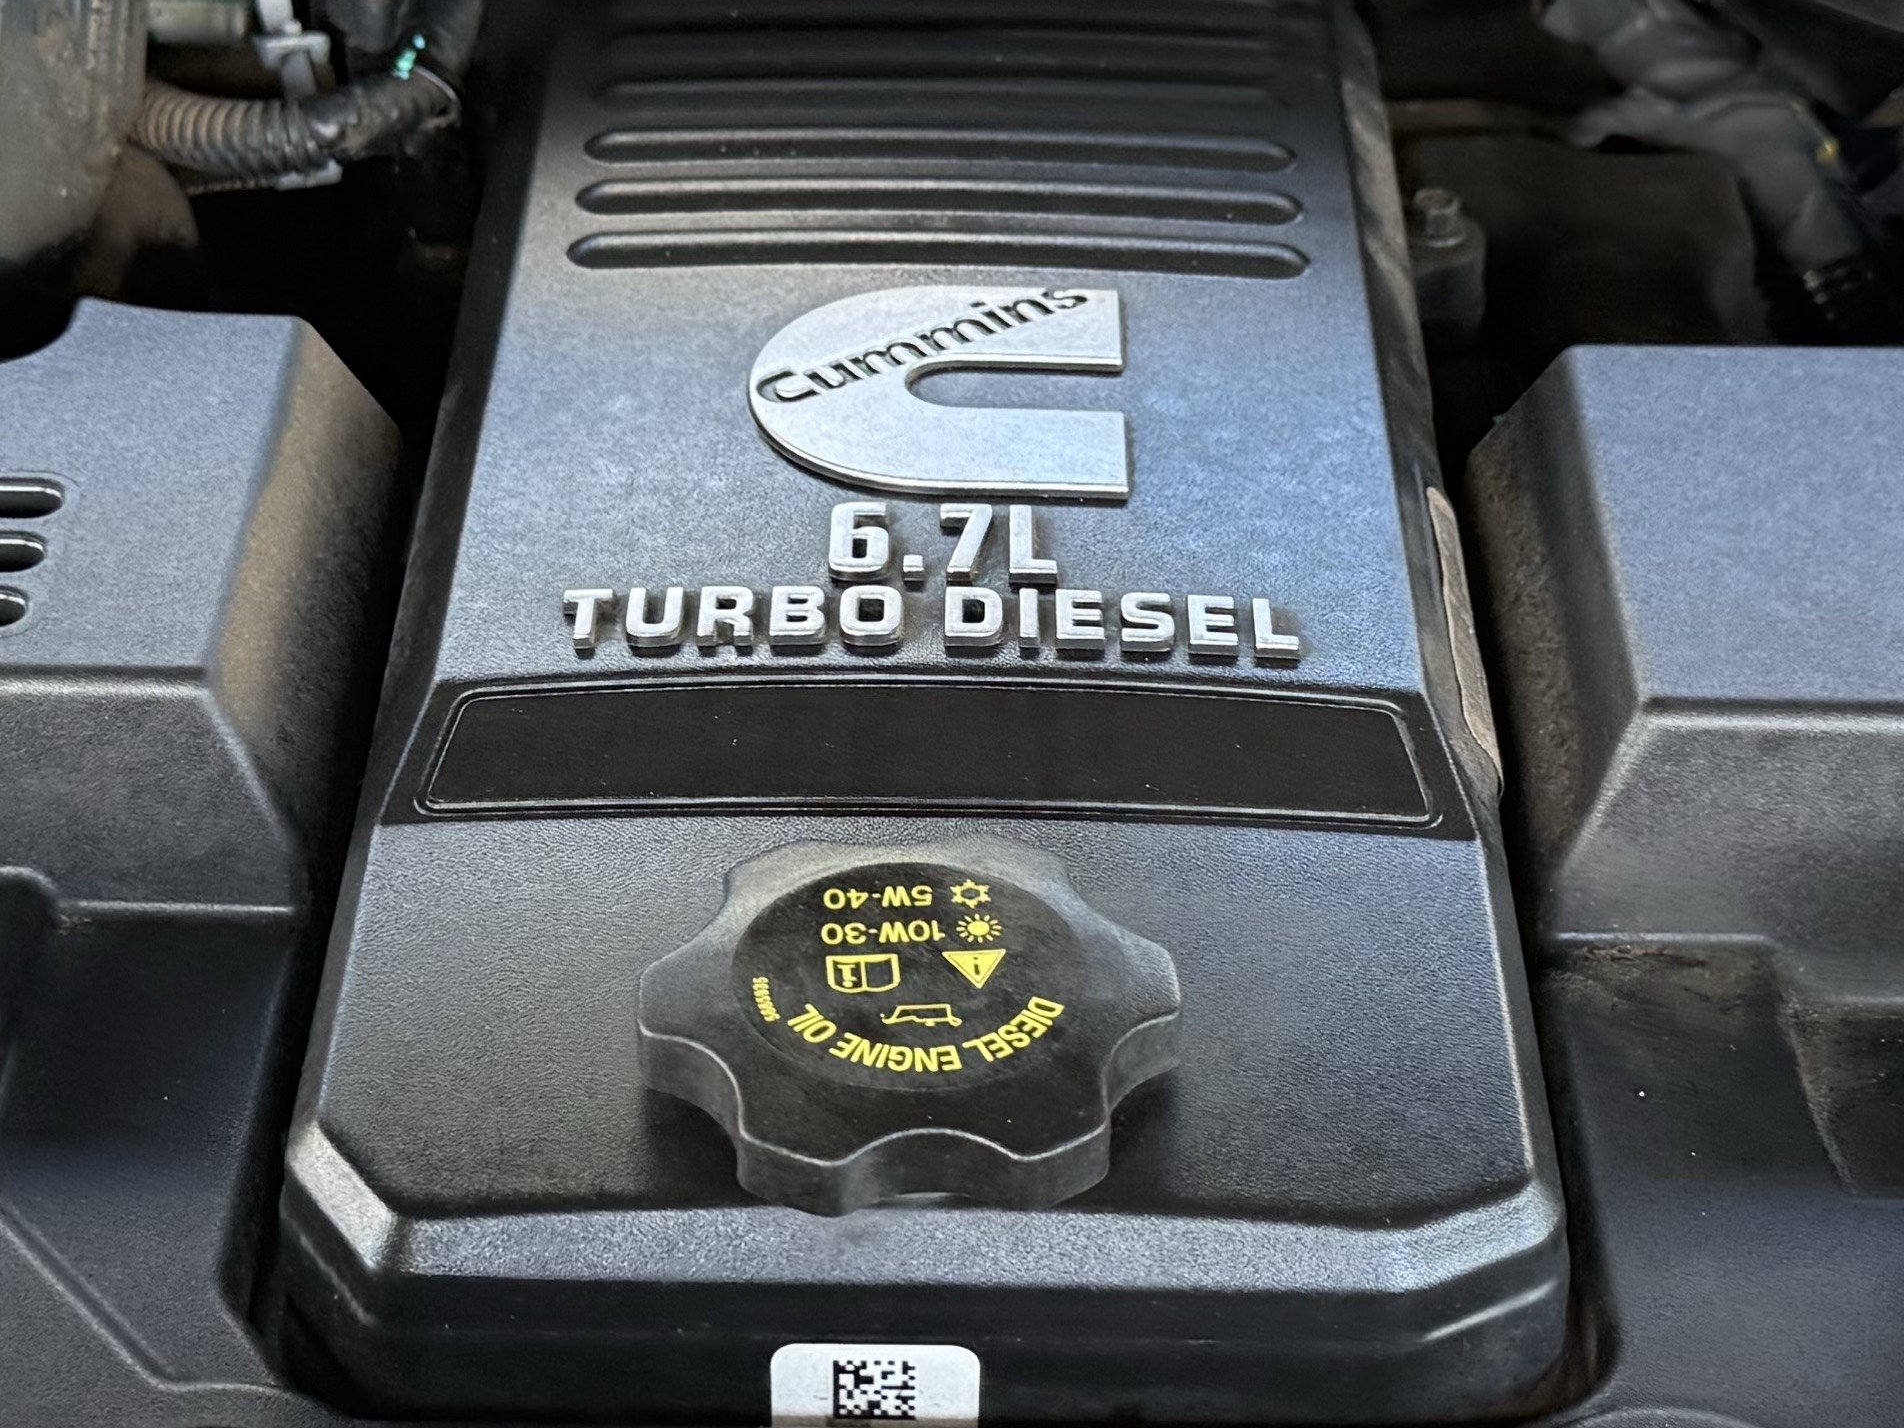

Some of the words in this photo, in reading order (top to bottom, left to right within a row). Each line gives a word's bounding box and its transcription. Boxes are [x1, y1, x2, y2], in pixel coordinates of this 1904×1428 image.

[755, 287, 1090, 404] Cummins
[827, 501, 1059, 584] 6.7L
[563, 584, 905, 648] TURBO
[944, 586, 1300, 659] DIESEL
[823, 885, 934, 910] 5W-40
[821, 919, 946, 945] 10W-30
[788, 1003, 838, 1045] OIL
[967, 997, 1064, 1061] DIESEL
[830, 1034, 963, 1073] ENGINE
